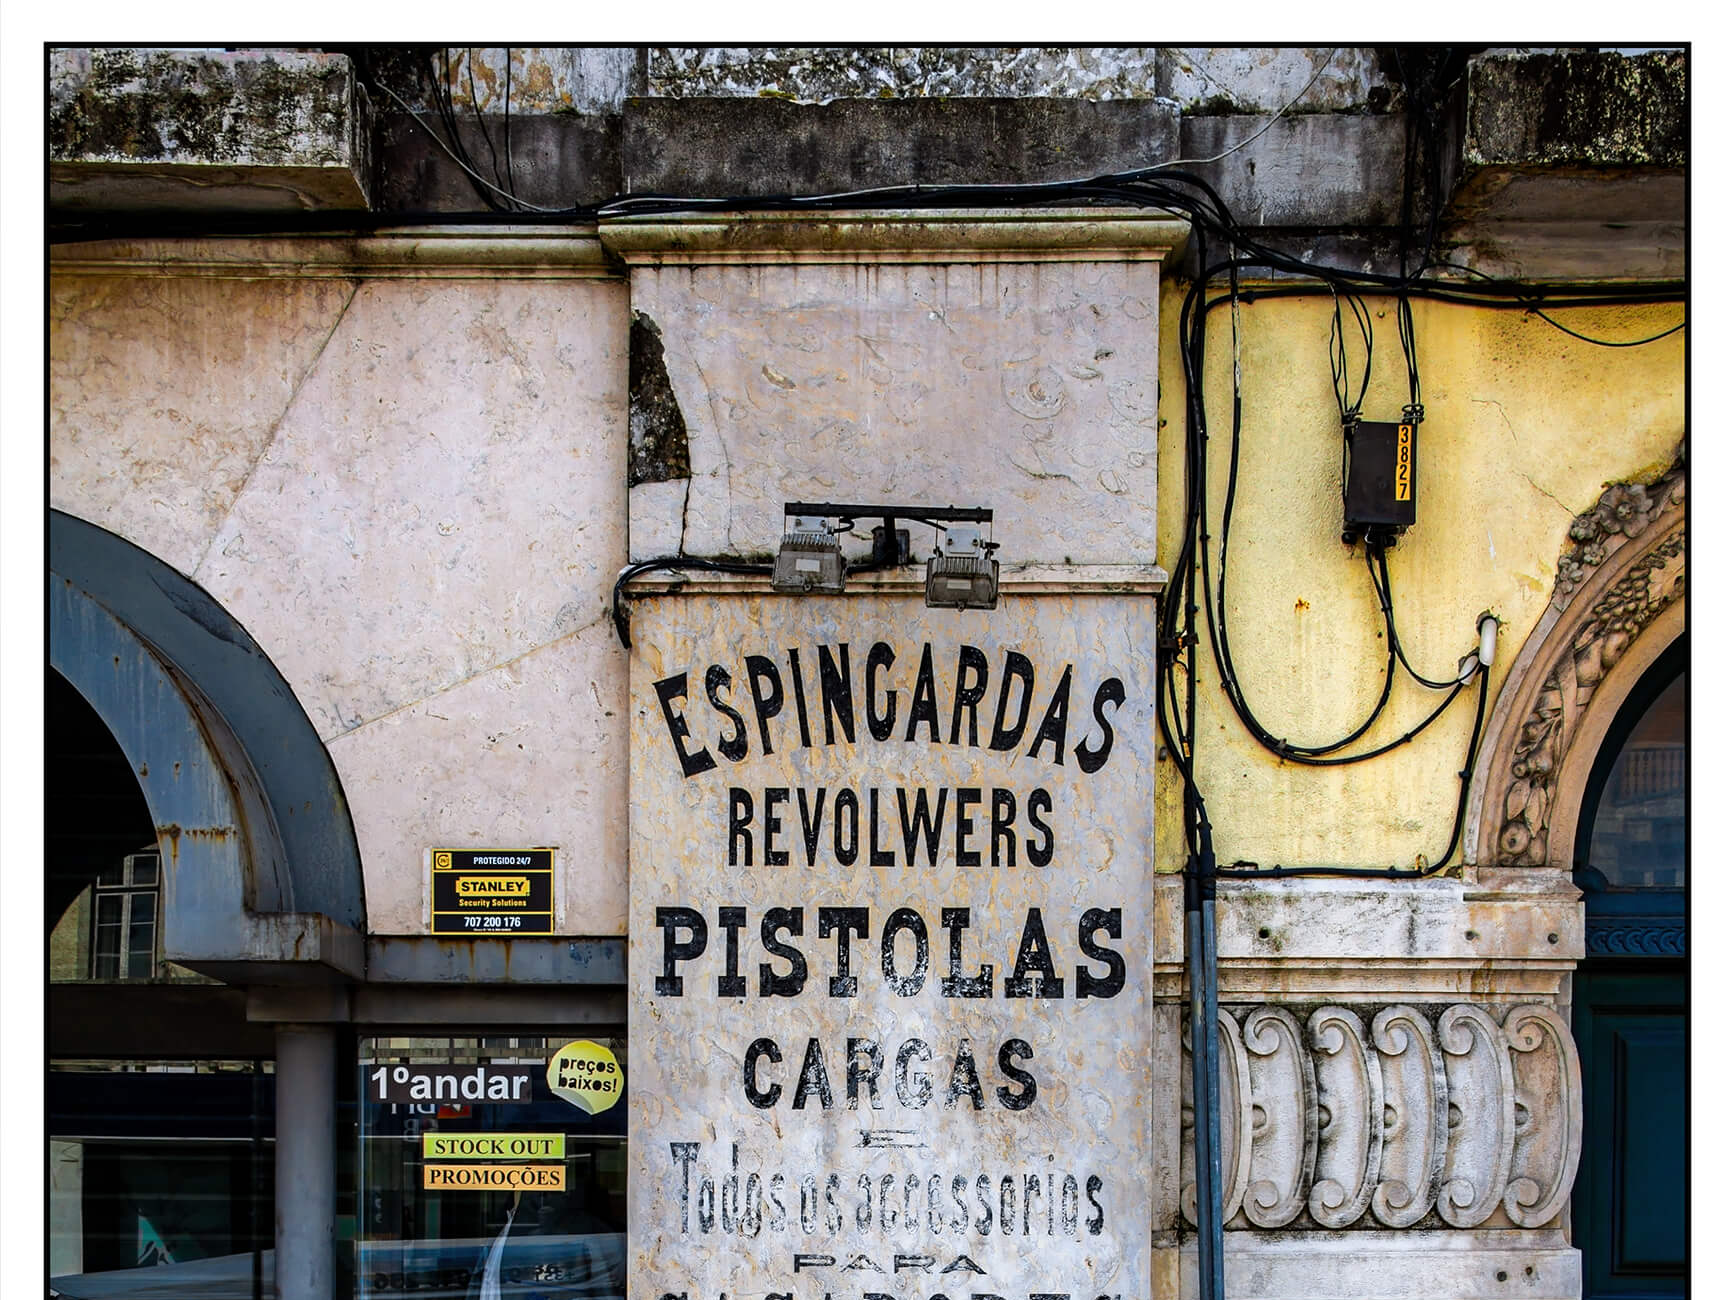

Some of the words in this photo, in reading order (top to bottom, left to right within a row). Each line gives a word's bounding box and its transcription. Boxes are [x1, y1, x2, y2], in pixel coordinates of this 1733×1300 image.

[1399, 426, 1409, 498] 3827
[652, 640, 1128, 778] ESPINGARDAS
[728, 786, 1054, 868] REVOLWERS
[473, 857, 515, 865] PROTEGIDO
[516, 857, 531, 865] 24/7
[461, 882, 524, 892] STANLEY
[459, 899, 489, 908] Security
[492, 899, 526, 907] Solutions
[464, 917, 481, 927] 707
[484, 917, 501, 927] 200
[504, 917, 521, 927] 176
[655, 907, 1126, 999] PISTOLAS
[560, 1056, 616, 1075] preços
[743, 1038, 1038, 1110] CARGAS
[558, 1074, 617, 1092] baixos!
[435, 1139, 505, 1154] STOCK
[511, 1139, 554, 1154] OUT
[430, 1167, 560, 1188] PROMOÇÕES
[669, 1142, 786, 1238] Todos
[801, 1173, 842, 1236] os
[794, 1253, 988, 1275] PARA
